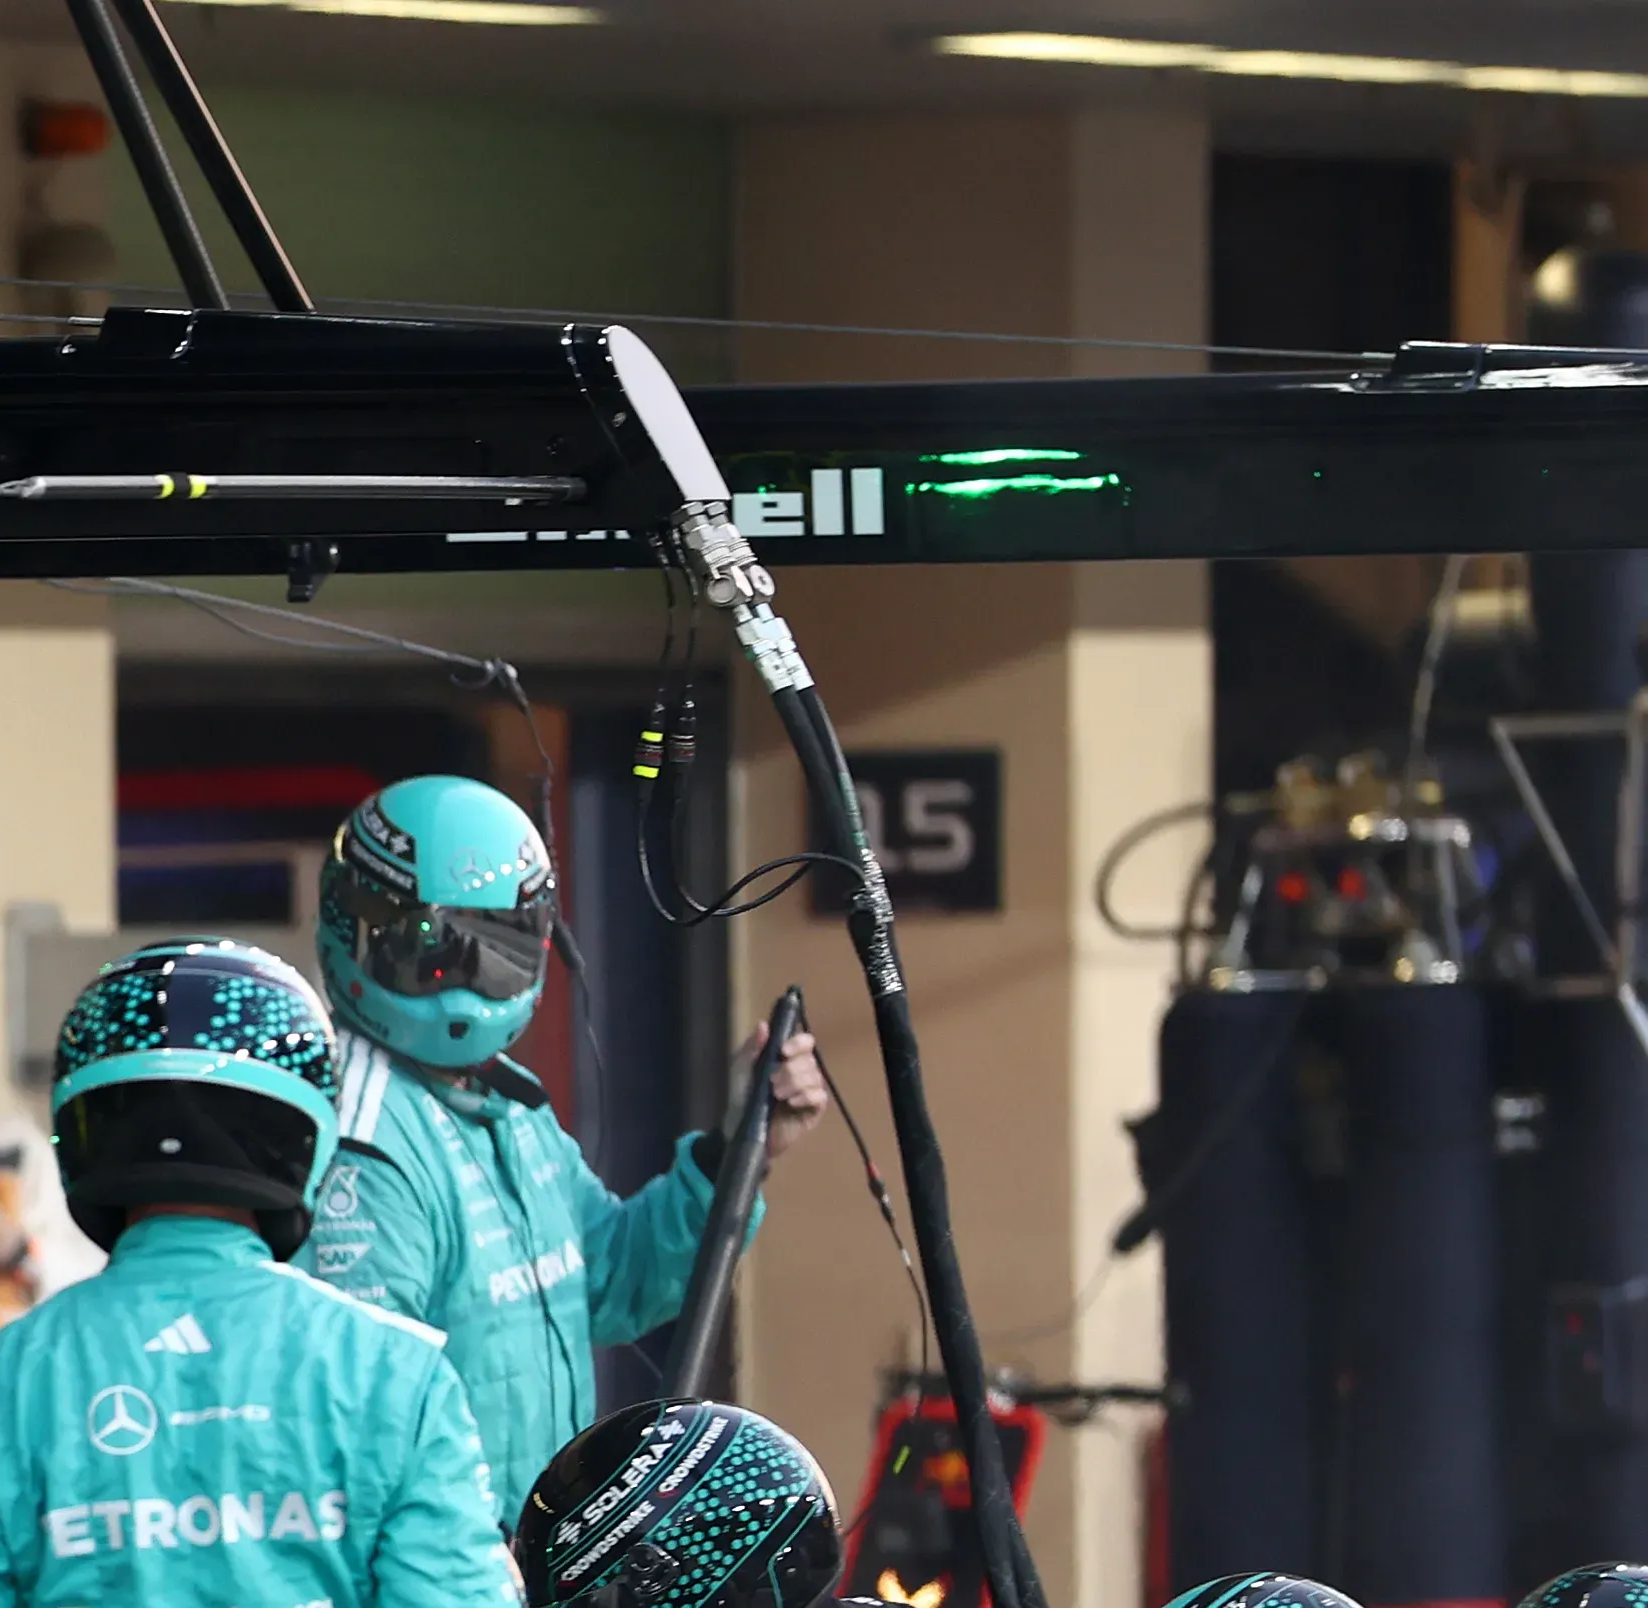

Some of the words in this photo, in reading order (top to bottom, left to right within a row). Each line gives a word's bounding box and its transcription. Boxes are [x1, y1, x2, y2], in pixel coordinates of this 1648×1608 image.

[582, 1442, 673, 1527] SOLERA
[658, 1416, 730, 1494] CROWDSTRIKE
[45, 1489, 347, 1558] ETRONAS
[561, 1500, 656, 1581] CROWDSTRIKE
